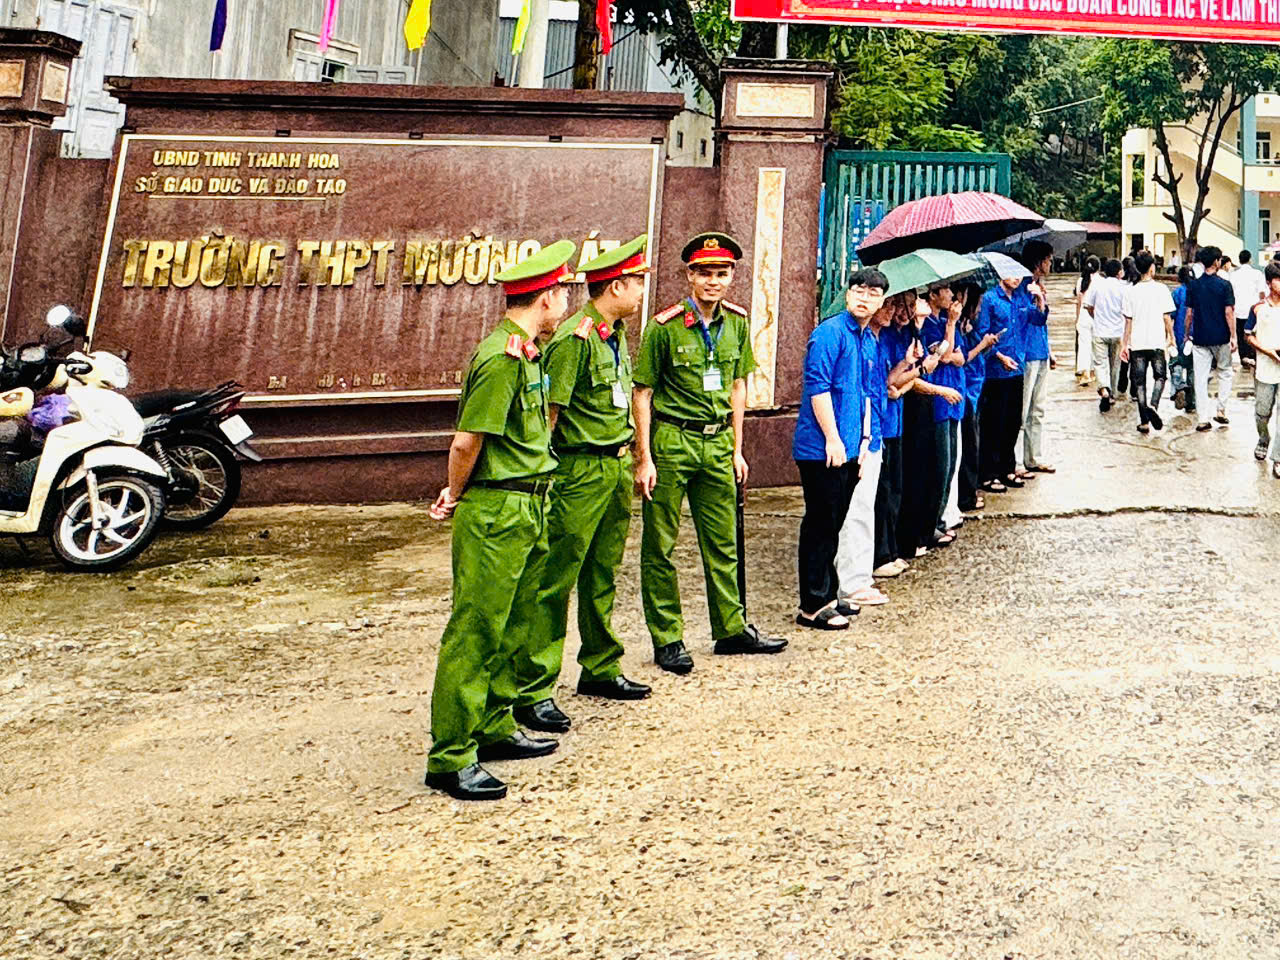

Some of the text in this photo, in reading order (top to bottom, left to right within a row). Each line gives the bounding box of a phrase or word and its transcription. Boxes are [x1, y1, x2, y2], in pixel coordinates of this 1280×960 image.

[152, 149, 200, 167] UBND
[247, 151, 302, 169] THANH
[274, 173, 309, 194] ĐÀO
[121, 230, 286, 288] TRƯỜNG
[297, 239, 395, 287] THPT
